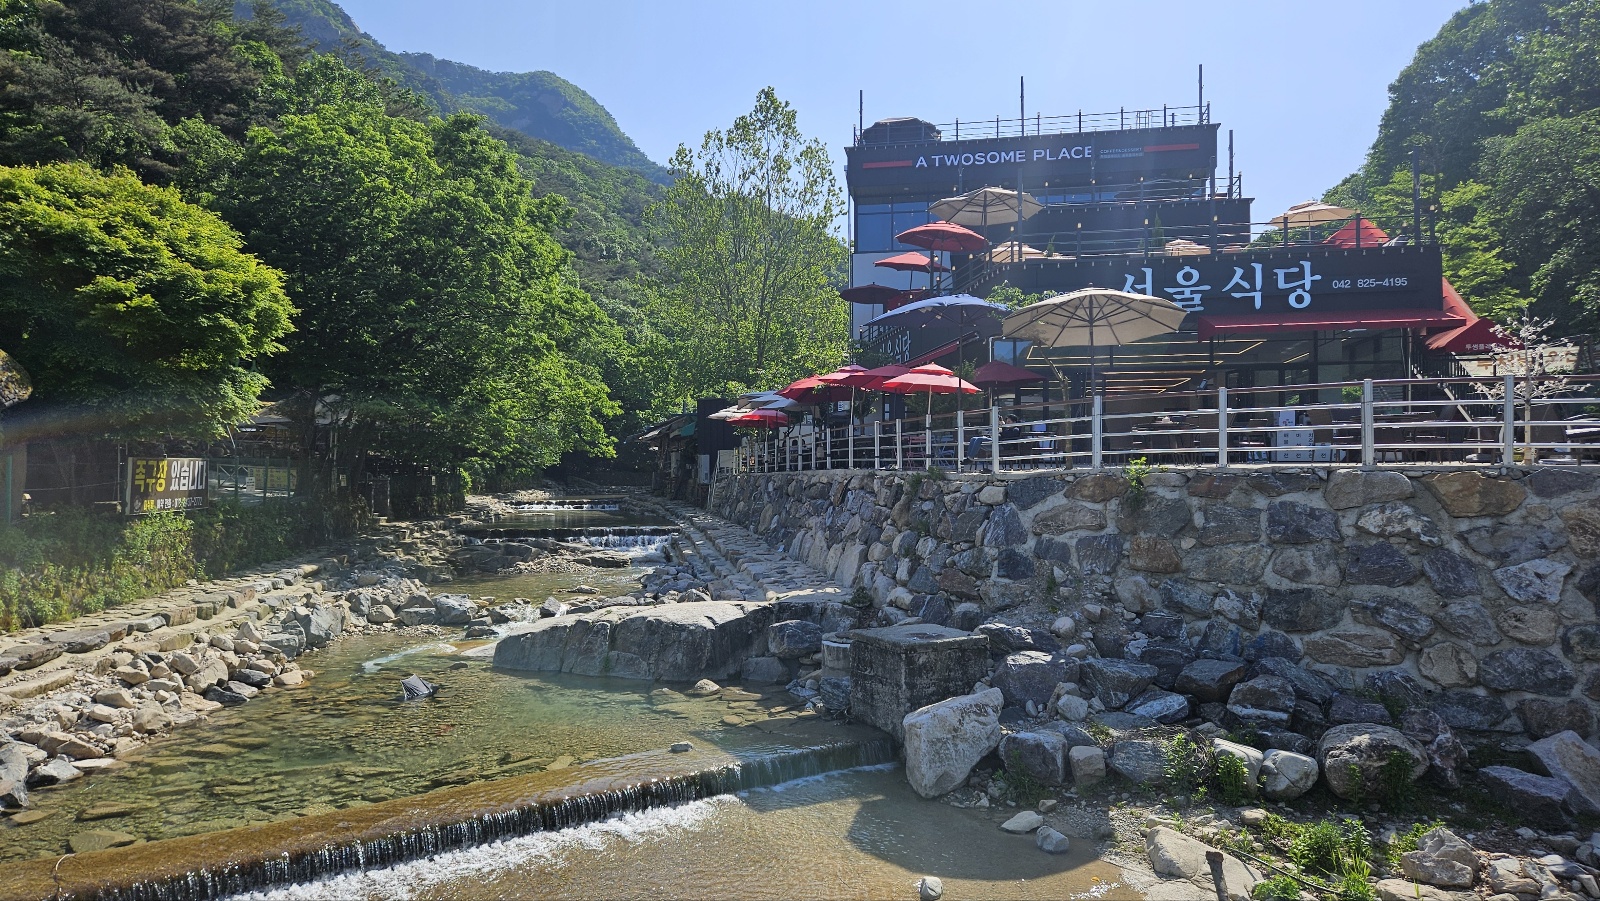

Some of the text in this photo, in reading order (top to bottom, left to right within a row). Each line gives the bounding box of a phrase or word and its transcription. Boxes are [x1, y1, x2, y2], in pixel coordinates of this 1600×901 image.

[915, 145, 1092, 168] A TWOSOME PLACE
[1122, 260, 1322, 314] 서울식당
[1332, 277, 1408, 289] 042 825-4195
[134, 460, 207, 493] 족구장 있습니다
